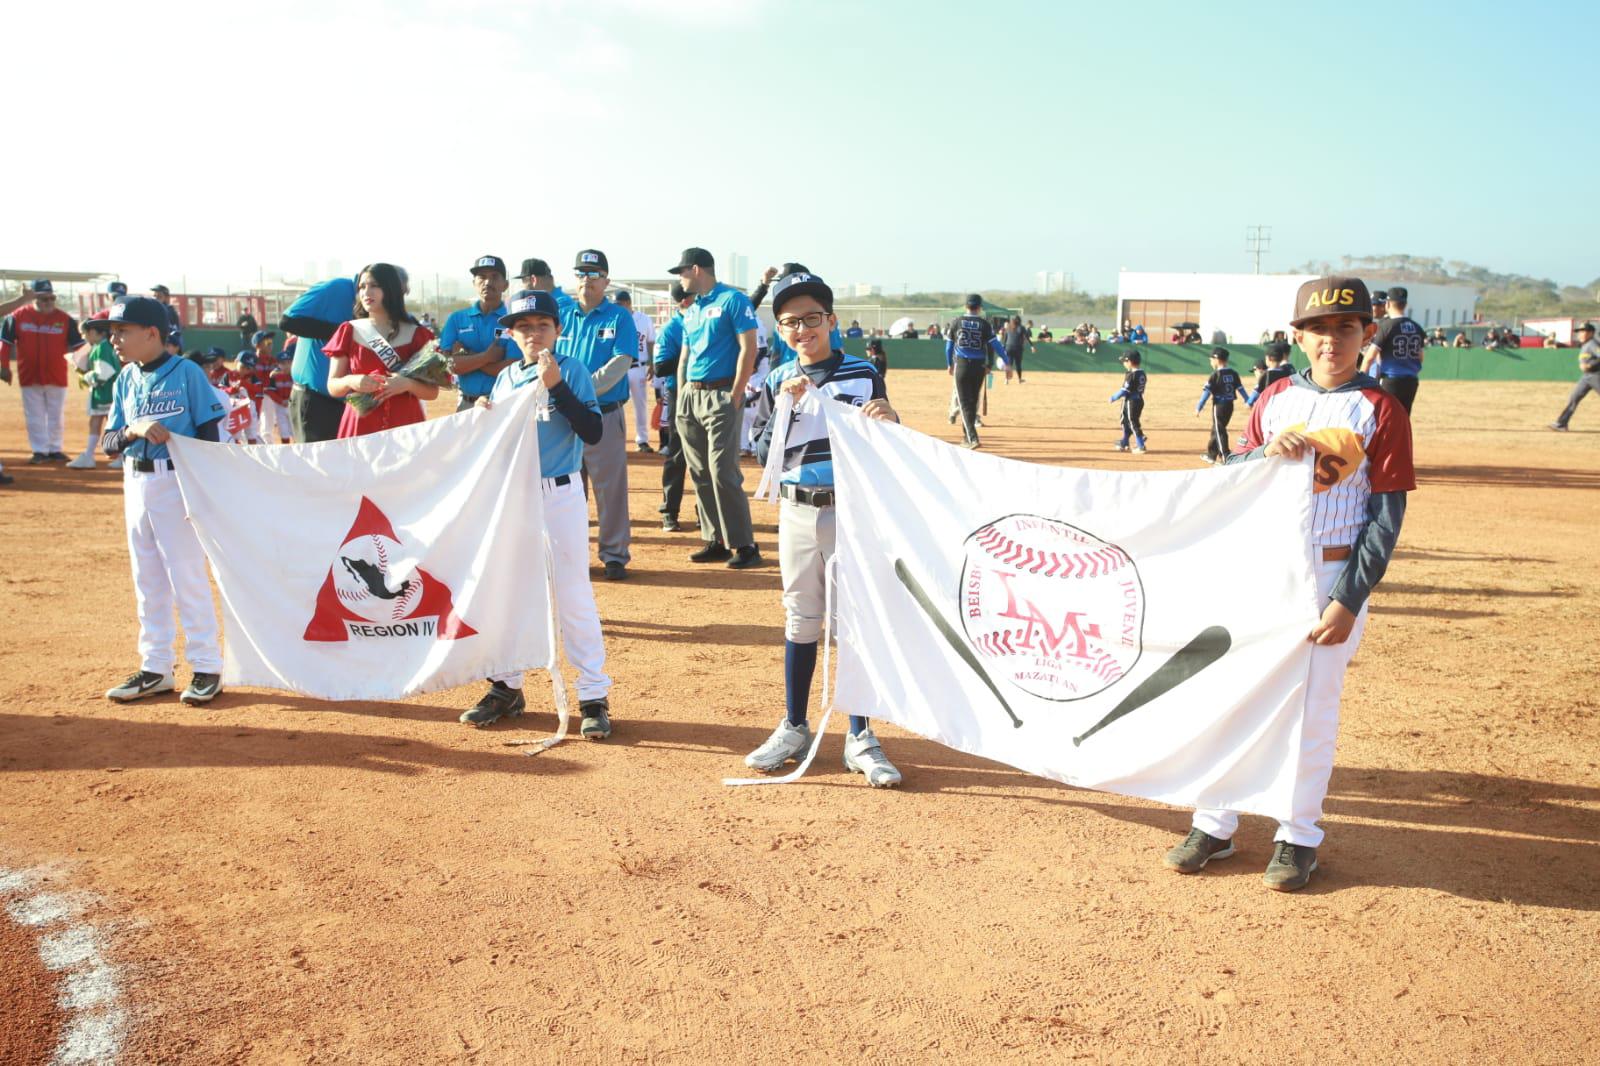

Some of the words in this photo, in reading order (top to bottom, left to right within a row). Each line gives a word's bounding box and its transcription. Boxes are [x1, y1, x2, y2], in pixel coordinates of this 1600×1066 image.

[1305, 288, 1355, 311] AUS
[349, 622, 419, 637] REGION
[423, 621, 436, 637] IV
[1034, 658, 1063, 671] LIGA
